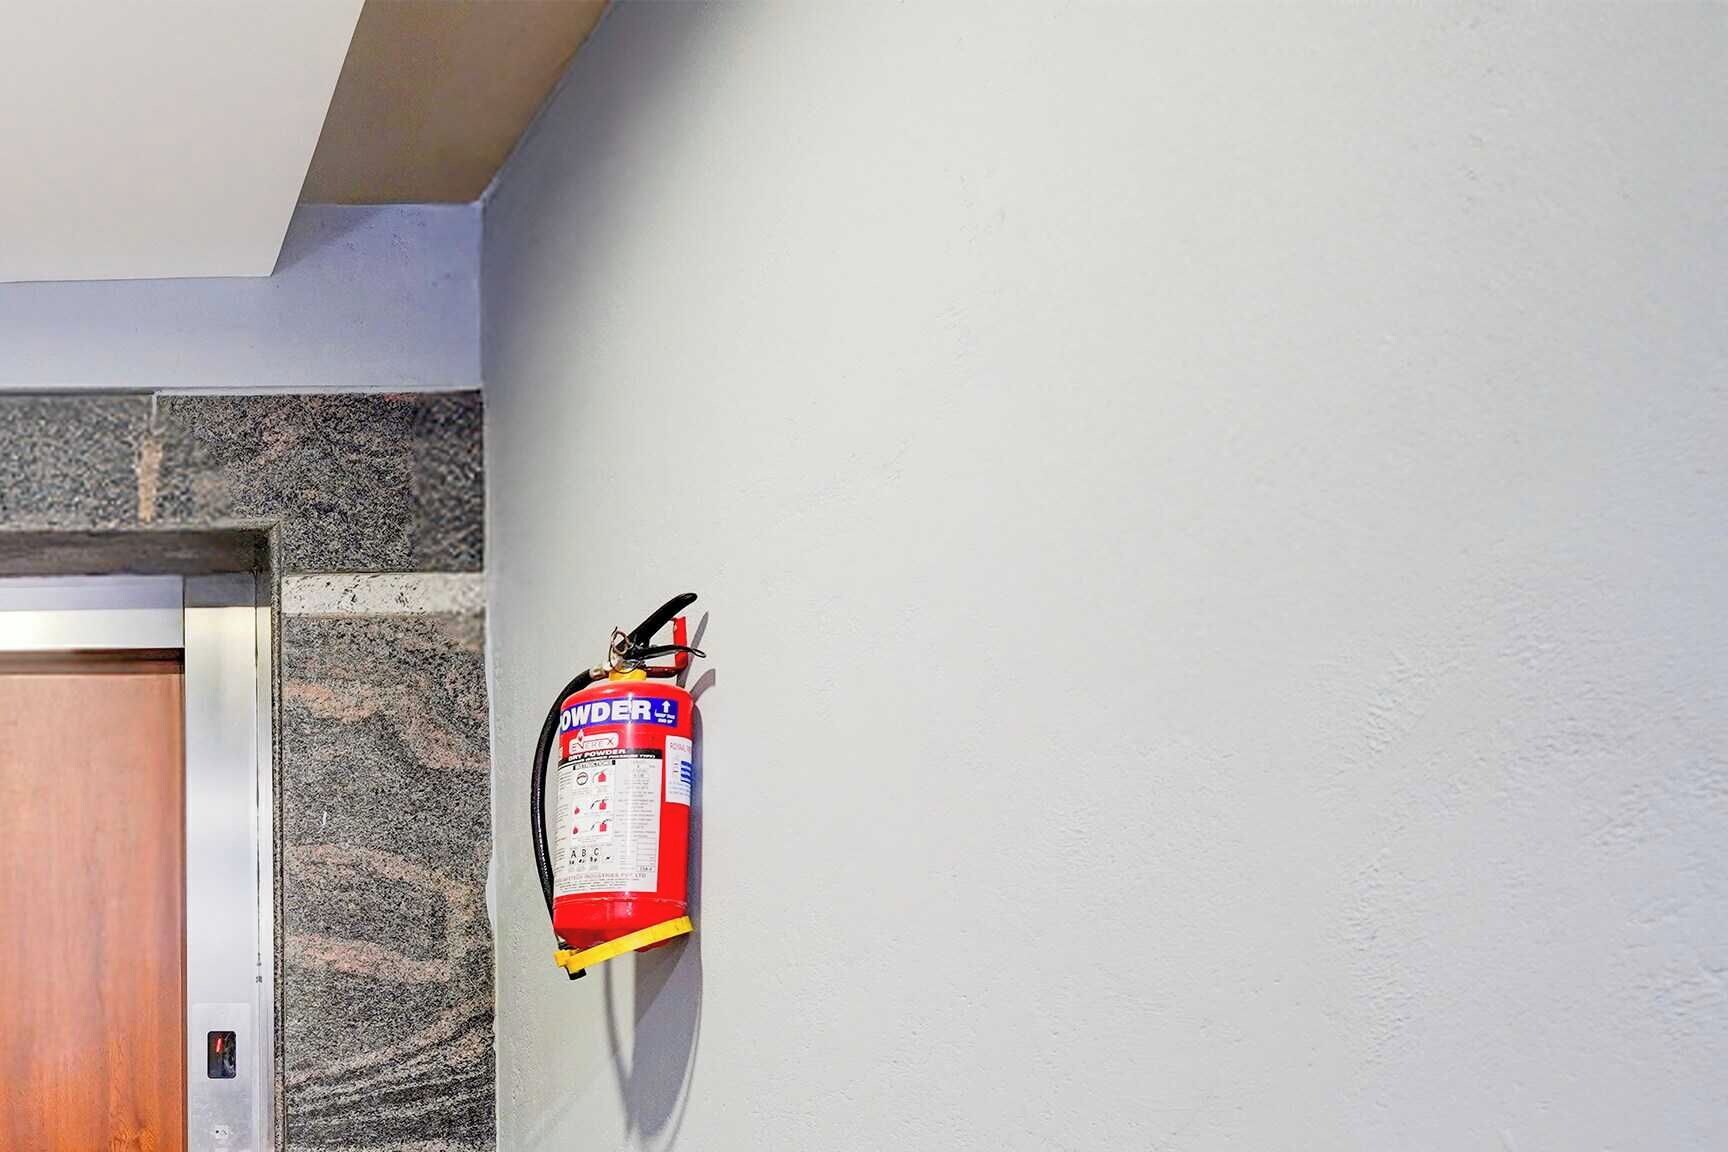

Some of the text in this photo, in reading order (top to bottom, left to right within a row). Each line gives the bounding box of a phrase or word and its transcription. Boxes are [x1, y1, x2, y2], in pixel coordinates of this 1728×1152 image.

[560, 699, 652, 731] OWDER
[584, 748, 626, 759] POWDER
[571, 847, 600, 858] A B C
